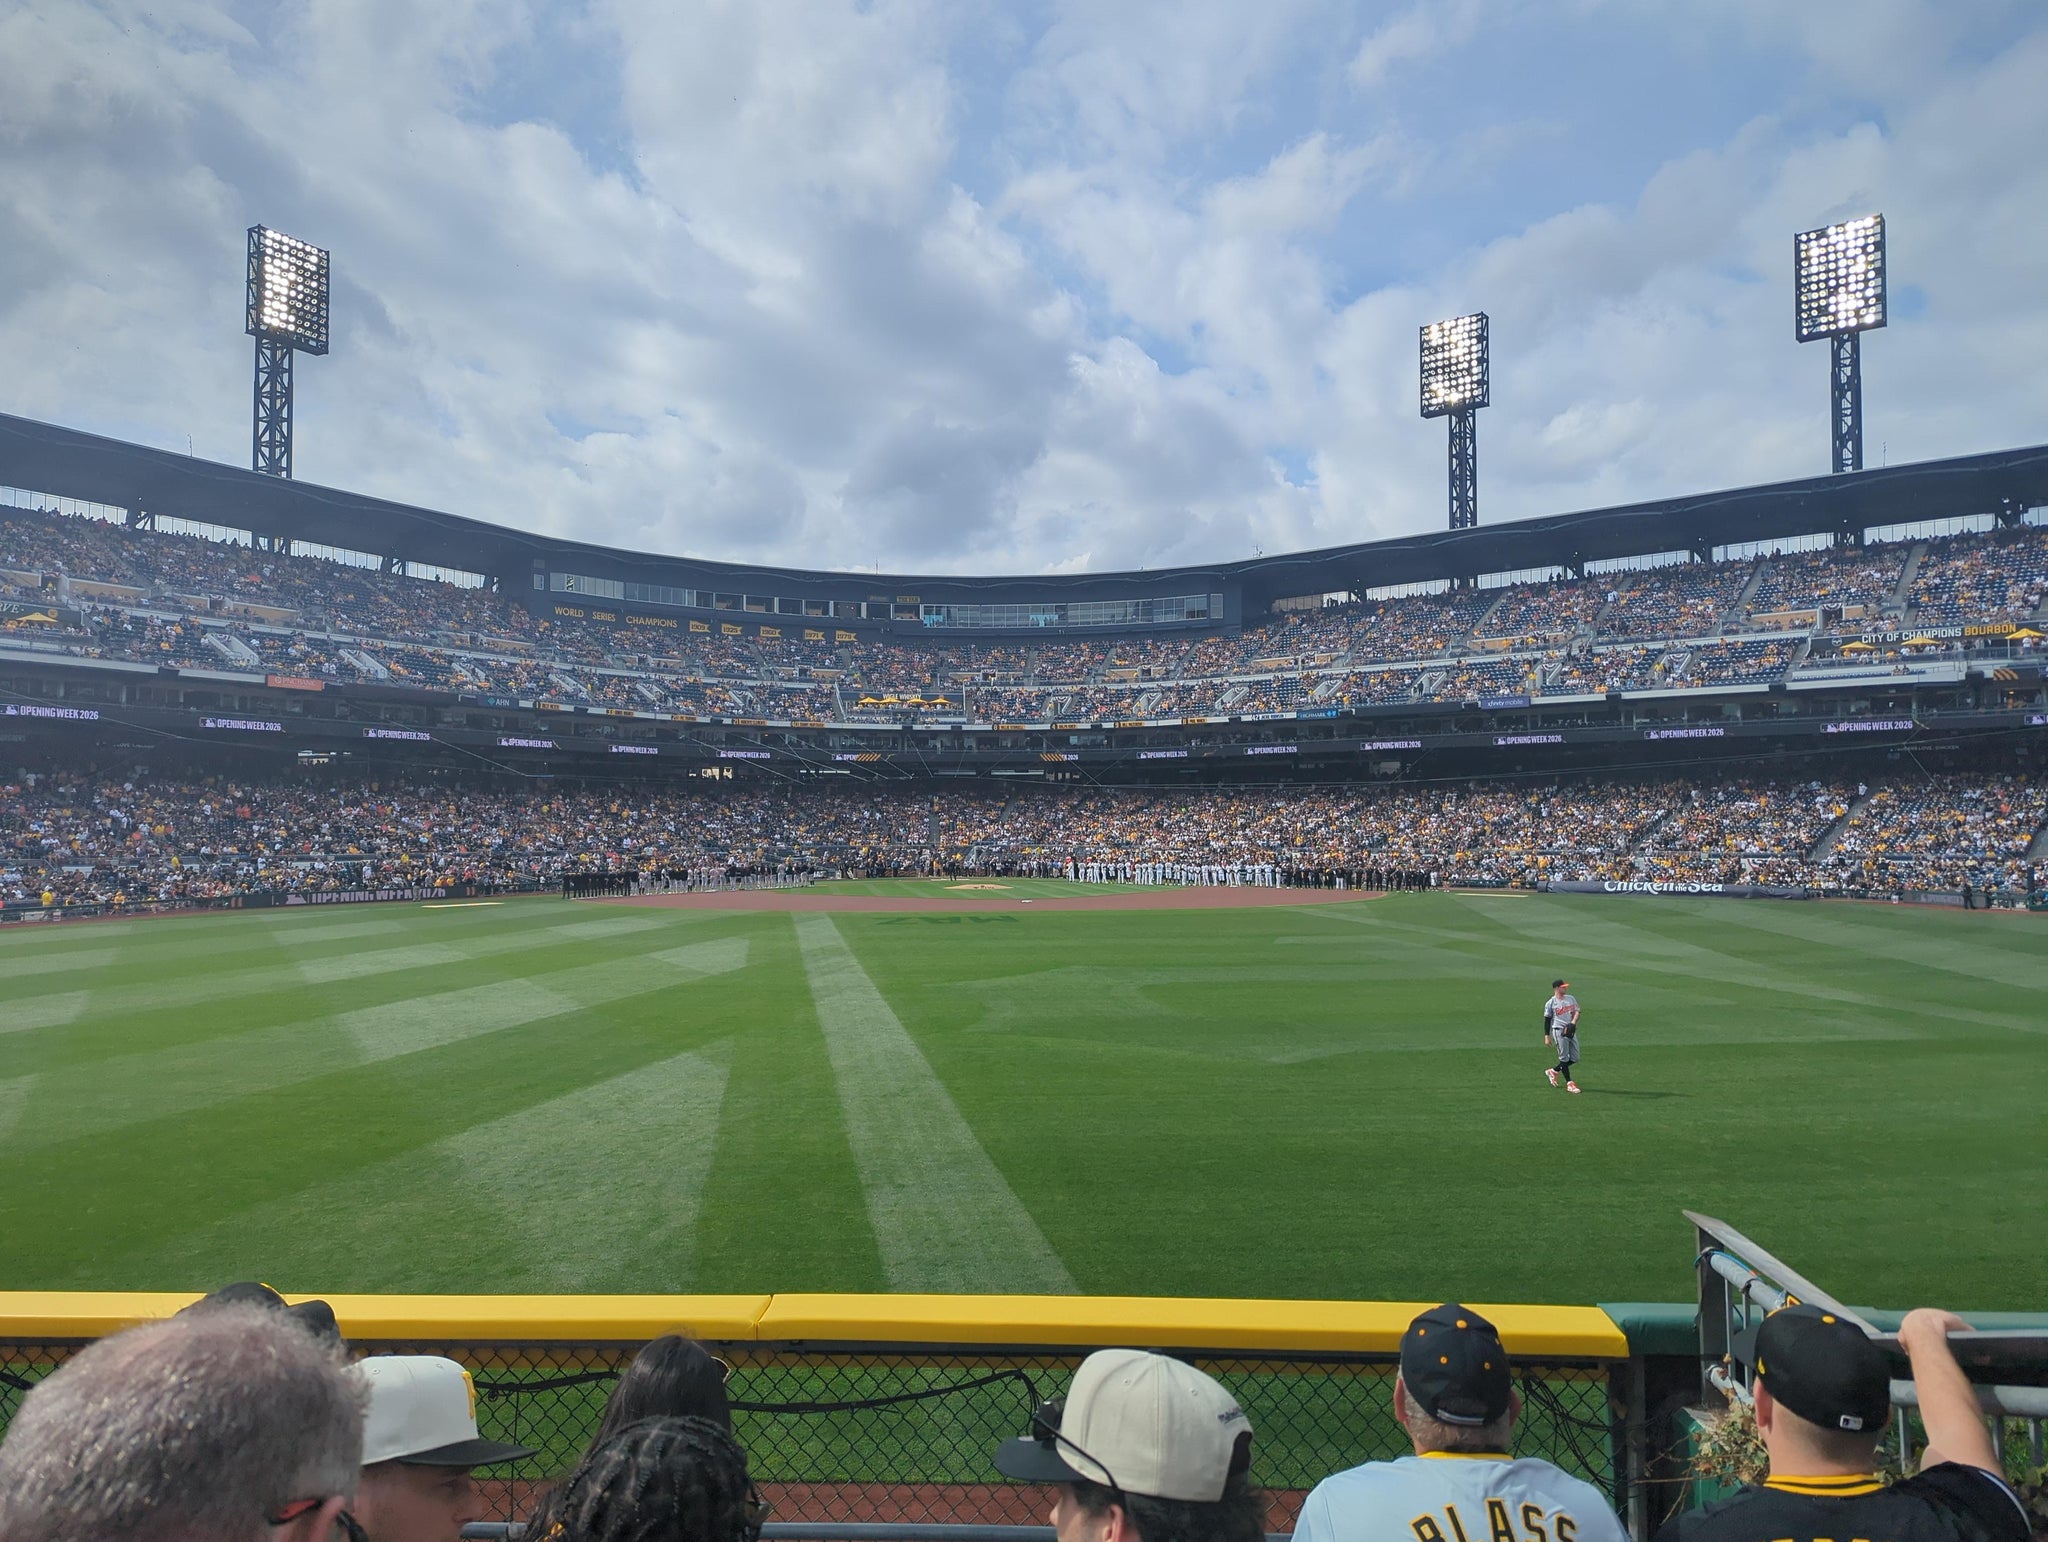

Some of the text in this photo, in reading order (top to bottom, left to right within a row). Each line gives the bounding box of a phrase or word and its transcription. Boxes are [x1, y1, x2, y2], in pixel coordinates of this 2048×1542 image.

[554, 606, 678, 628] WORLD SERIES CHAMPIONS
[691, 623, 706, 631] 1909
[723, 626, 738, 634] 1925
[1861, 623, 2017, 644] CITY OF CHAMPIONS BOURBON
[20, 705, 99, 720] OPENING WEEK 2026
[217, 718, 282, 732] OPENING WEEK 2026
[1839, 720, 1914, 732] OPENING WEEK 2026
[377, 729, 431, 741] OPENING WEEK 2026
[1660, 728, 1725, 739] OPENING WEEK 2026
[508, 737, 553, 749] OPENING WEEK 2026
[1372, 740, 1422, 750] OPENING WEEK 2026
[1506, 734, 1562, 745] OPENING WEEK 2026
[618, 745, 659, 755] OPENING WEEK 2026
[727, 751, 748, 759] OPENING
[1147, 751, 1166, 759] OPENING
[1177, 750, 1188, 758] 2026
[1254, 745, 1298, 755] OPENING WEEK 2026
[1603, 881, 1674, 895] Chicken
[311, 890, 374, 903] OPENING
